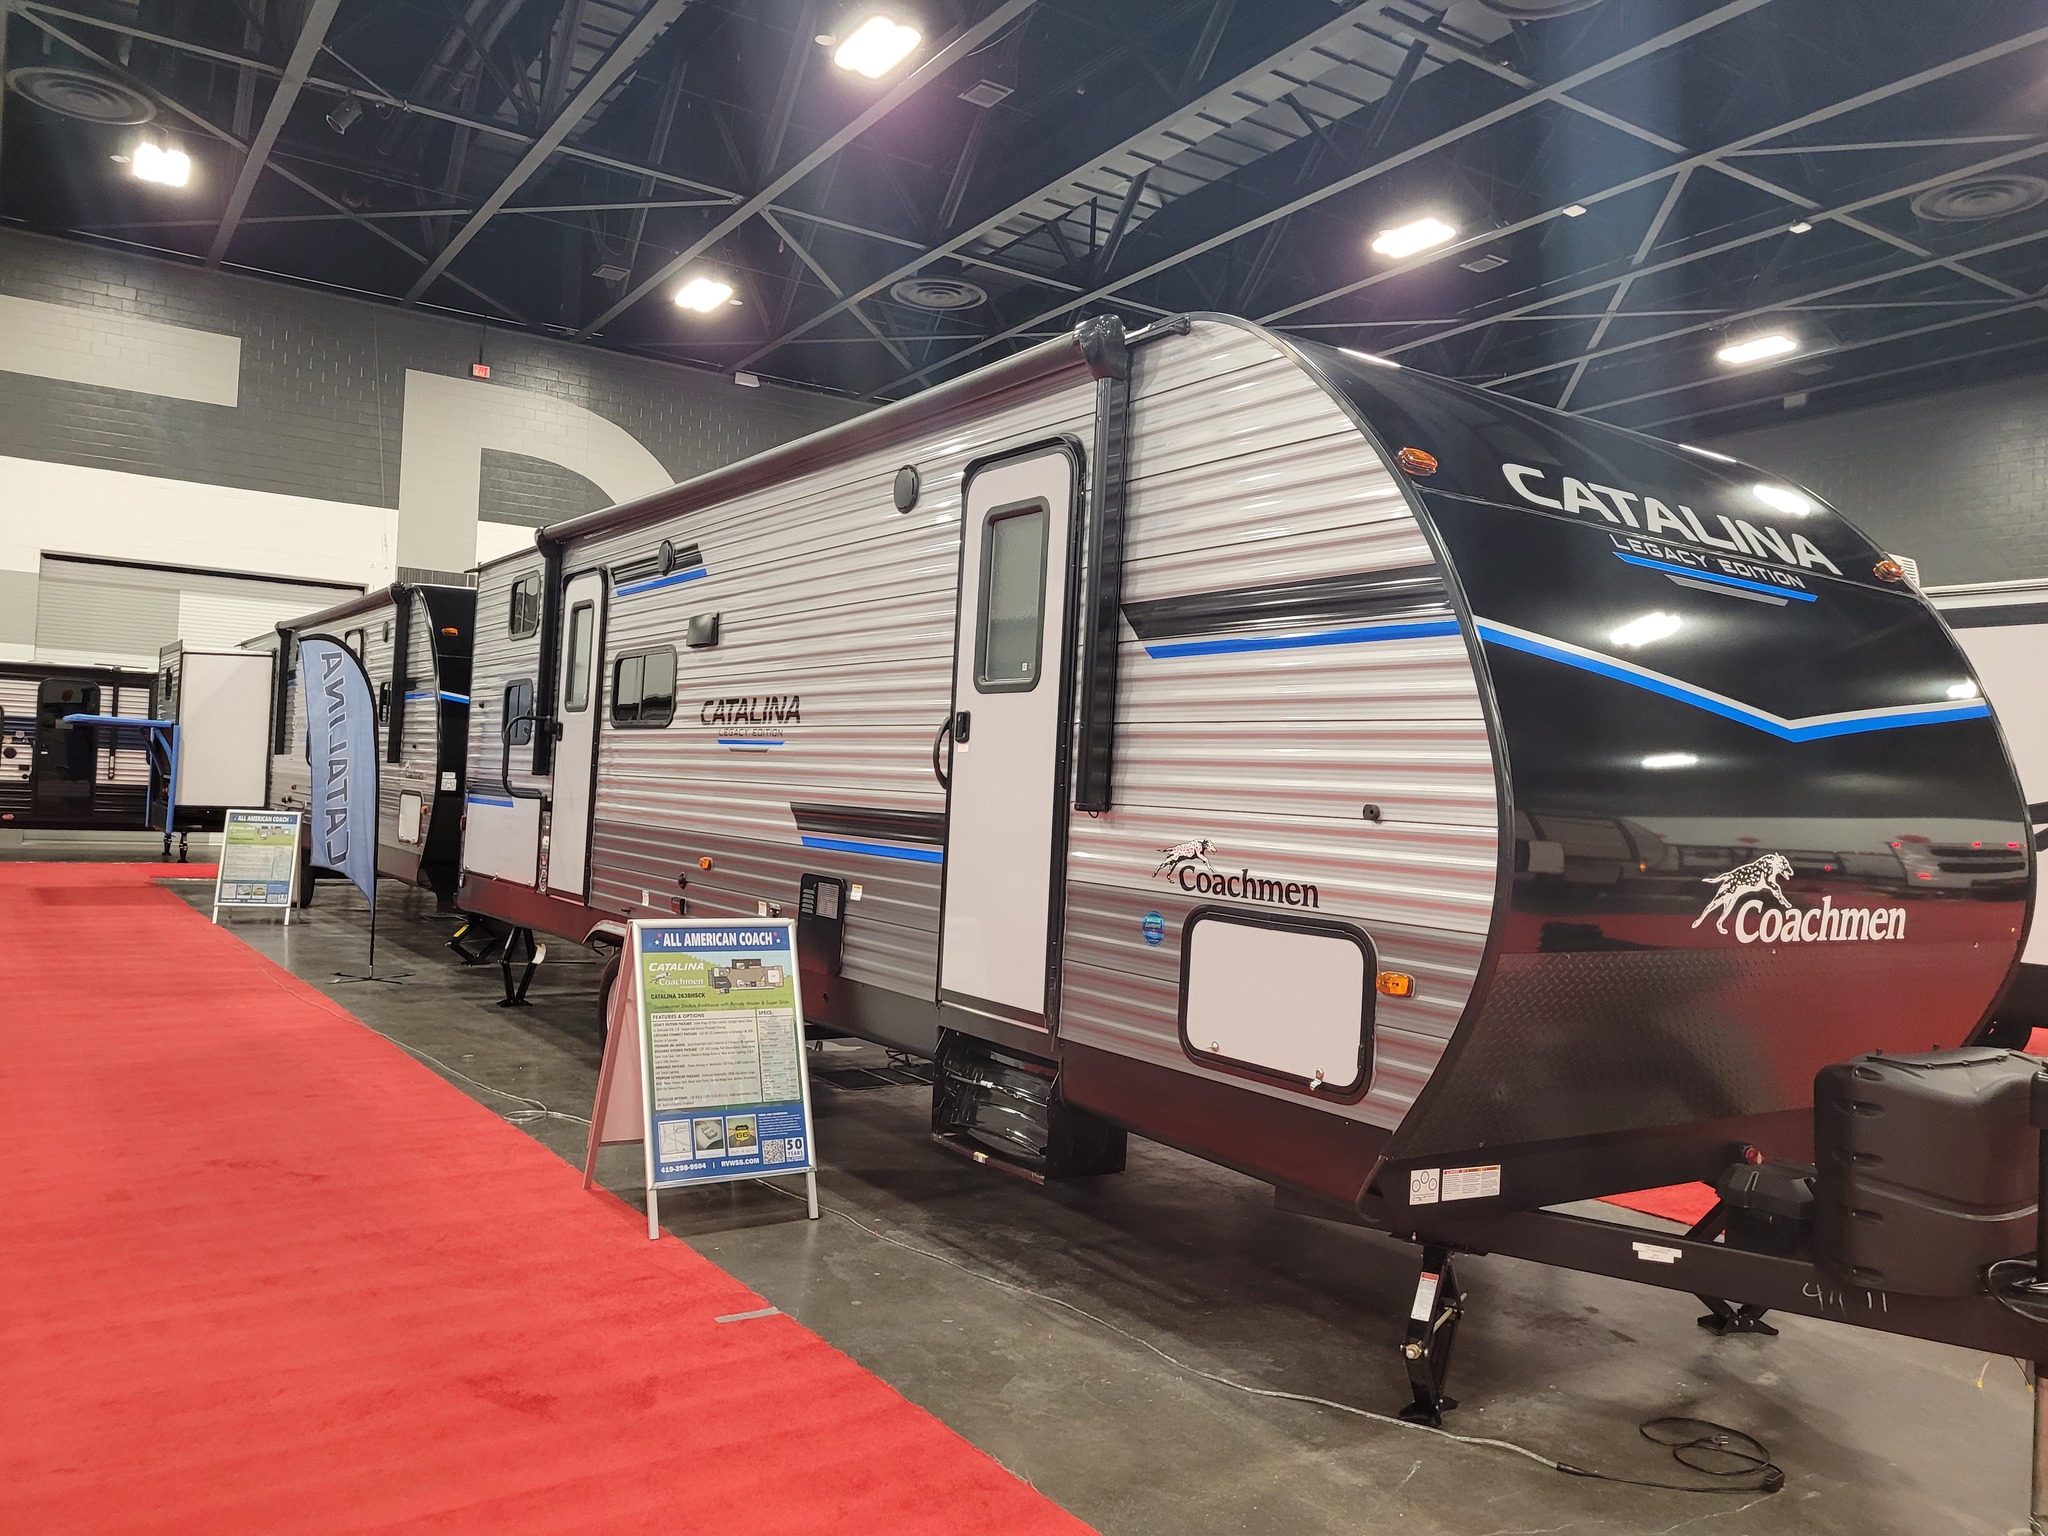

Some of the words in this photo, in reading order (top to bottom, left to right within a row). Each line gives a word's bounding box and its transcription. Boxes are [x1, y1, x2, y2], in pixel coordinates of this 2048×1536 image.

[1502, 463, 1843, 576] CATALINA
[1609, 533, 1707, 568] LEGACY
[1720, 557, 1806, 589] EDITION
[700, 695, 801, 725] CATALINA
[718, 728, 750, 737] LEGACY
[752, 729, 784, 737] EDITION
[1178, 865, 1320, 909] Coachmen
[1735, 895, 1907, 943] Coachmen
[663, 932, 682, 947] ALL
[684, 932, 737, 946] AMERICAN
[739, 931, 773, 946] COACH
[648, 962, 704, 972] CATALINA
[659, 977, 704, 986] Coachmen
[786, 1138, 803, 1150] 50
[787, 1149, 804, 1157] YEARS
[721, 1157, 760, 1168] RVWSS.COM
